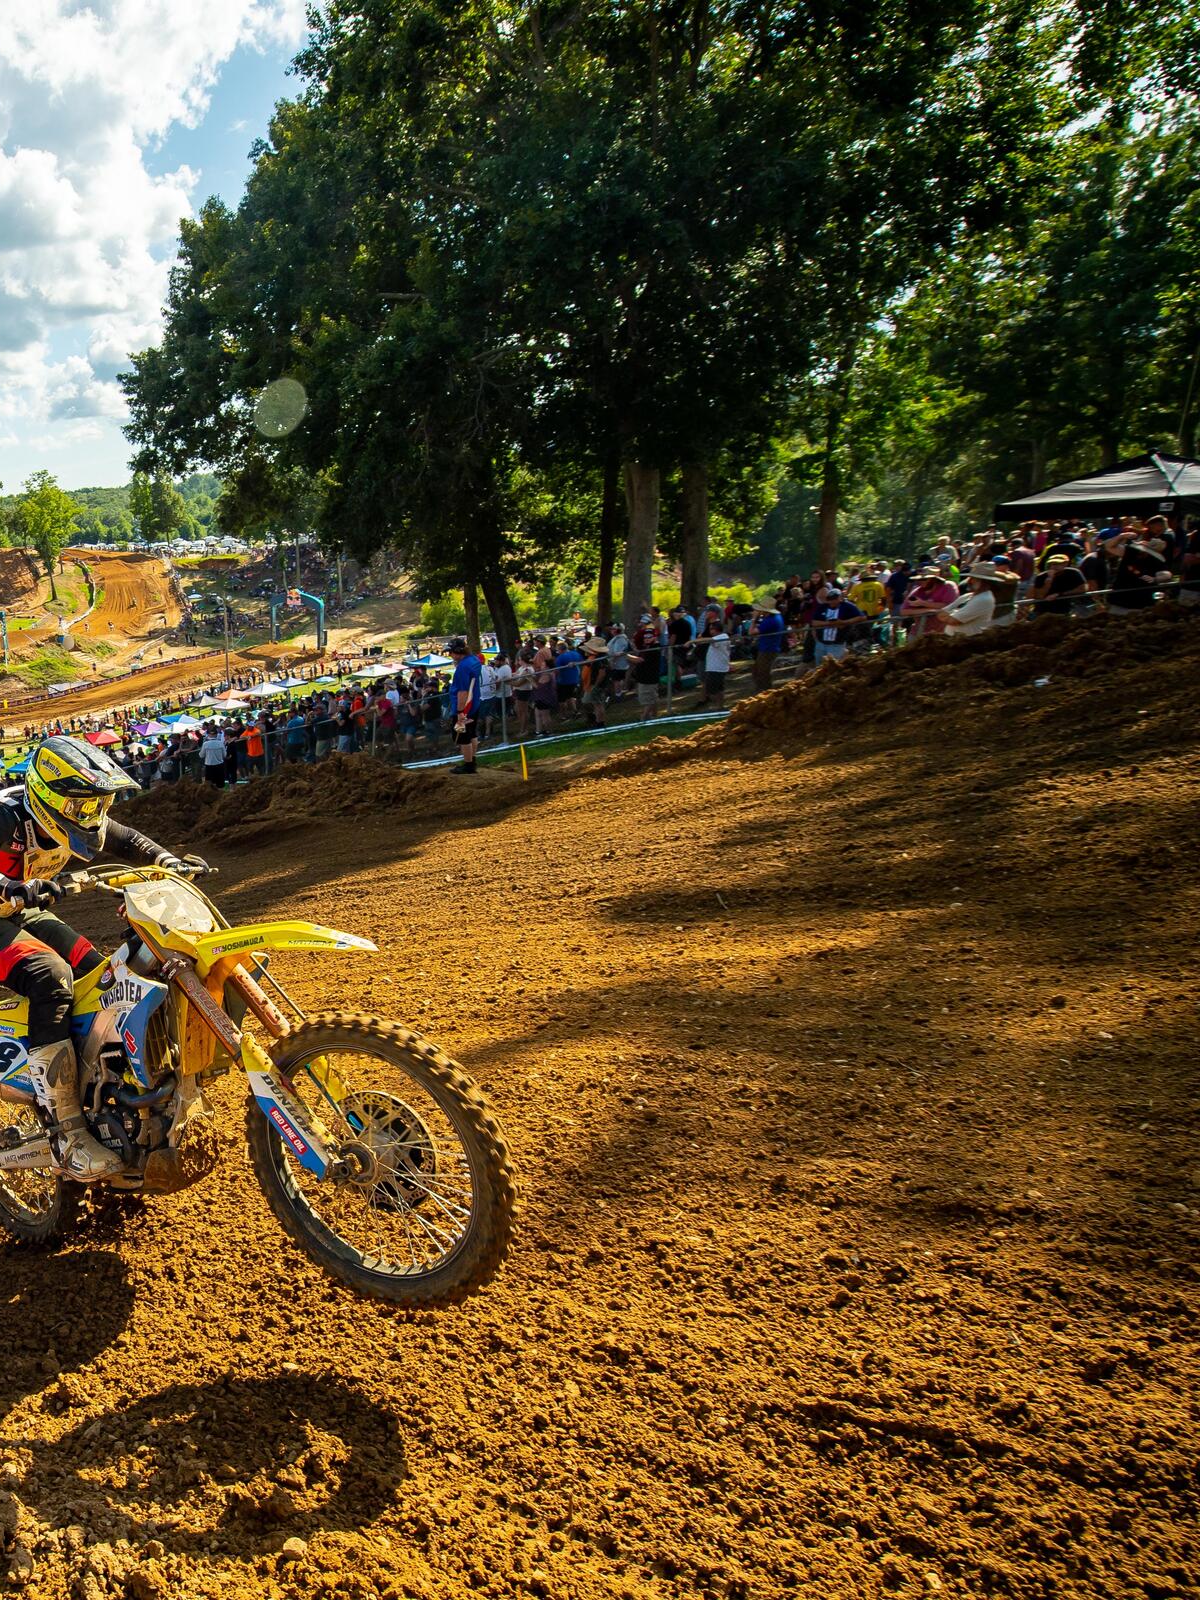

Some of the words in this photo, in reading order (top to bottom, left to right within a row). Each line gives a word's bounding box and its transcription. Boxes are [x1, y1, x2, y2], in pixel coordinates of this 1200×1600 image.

[222, 936, 264, 952] YOSHIMURA
[125, 979, 142, 1002] TEA
[261, 1074, 313, 1136] DUNLOP
[271, 1110, 285, 1125] RED
[281, 1124, 297, 1141] LINE
[293, 1138, 307, 1153] OIL
